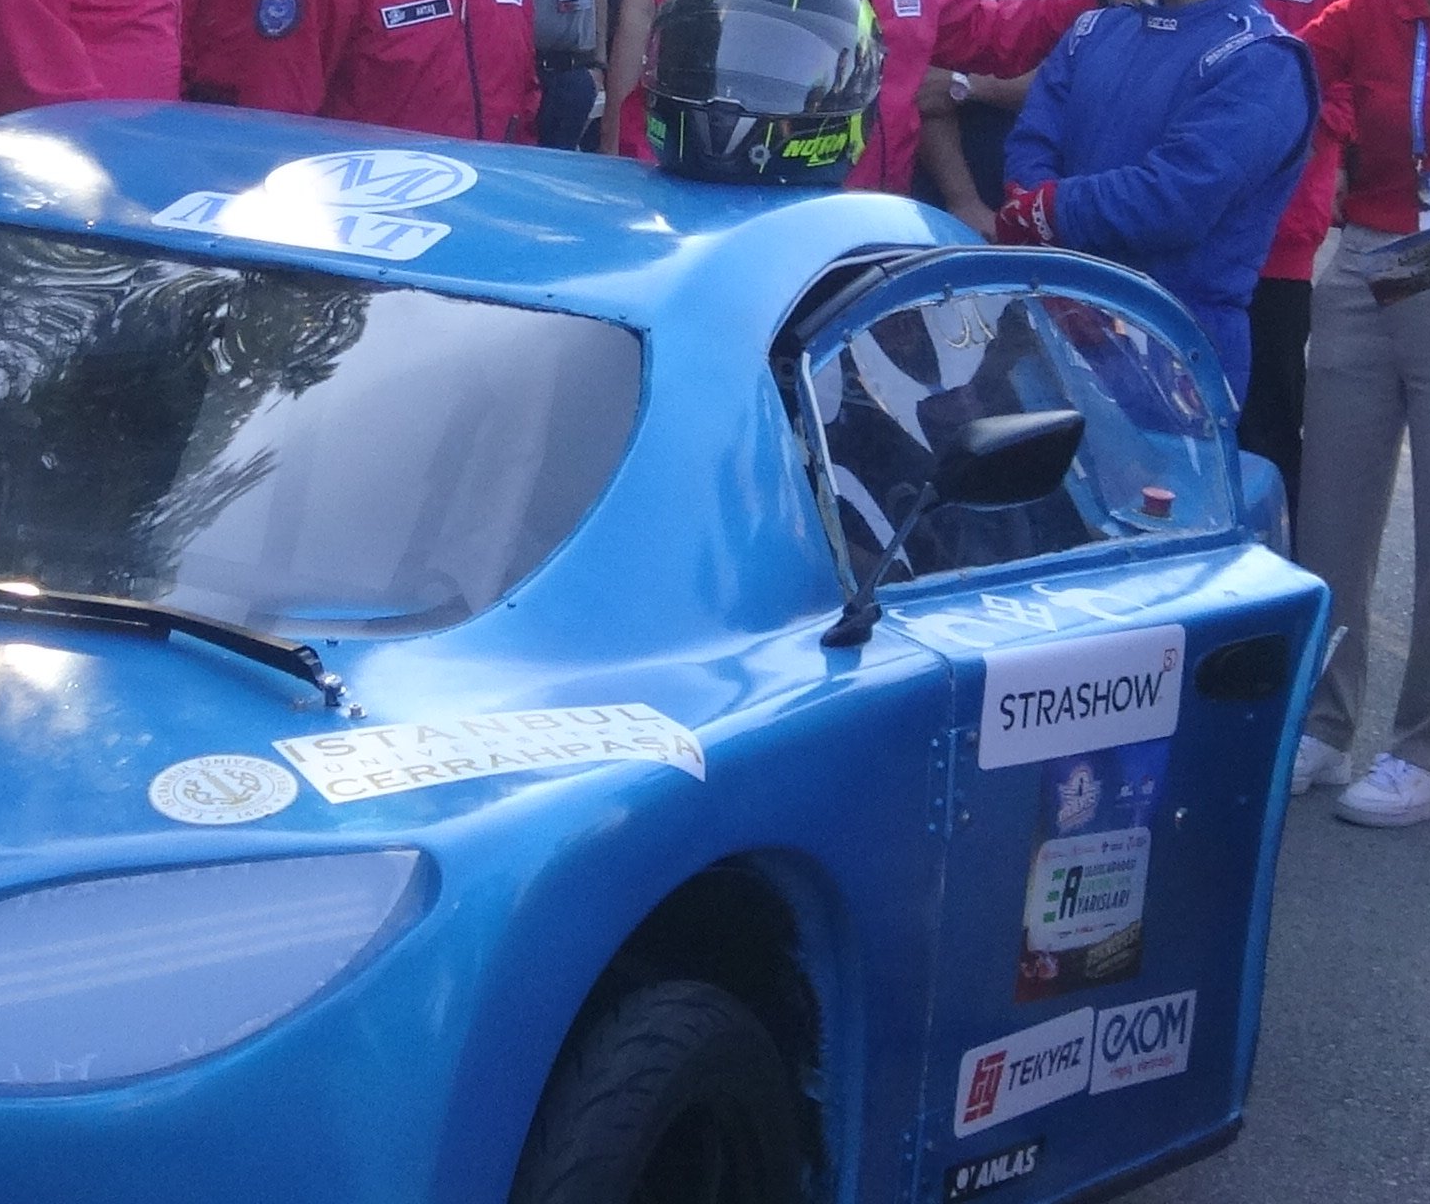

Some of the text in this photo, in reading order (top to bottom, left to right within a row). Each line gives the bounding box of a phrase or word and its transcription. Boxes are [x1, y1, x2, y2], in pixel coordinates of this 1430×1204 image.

[999, 670, 1164, 731] STRASHOW
[280, 705, 660, 764] İSTANBUL
[325, 734, 703, 797] CERRAHPAŞA
[1008, 1037, 1085, 1091] TEKYAZ
